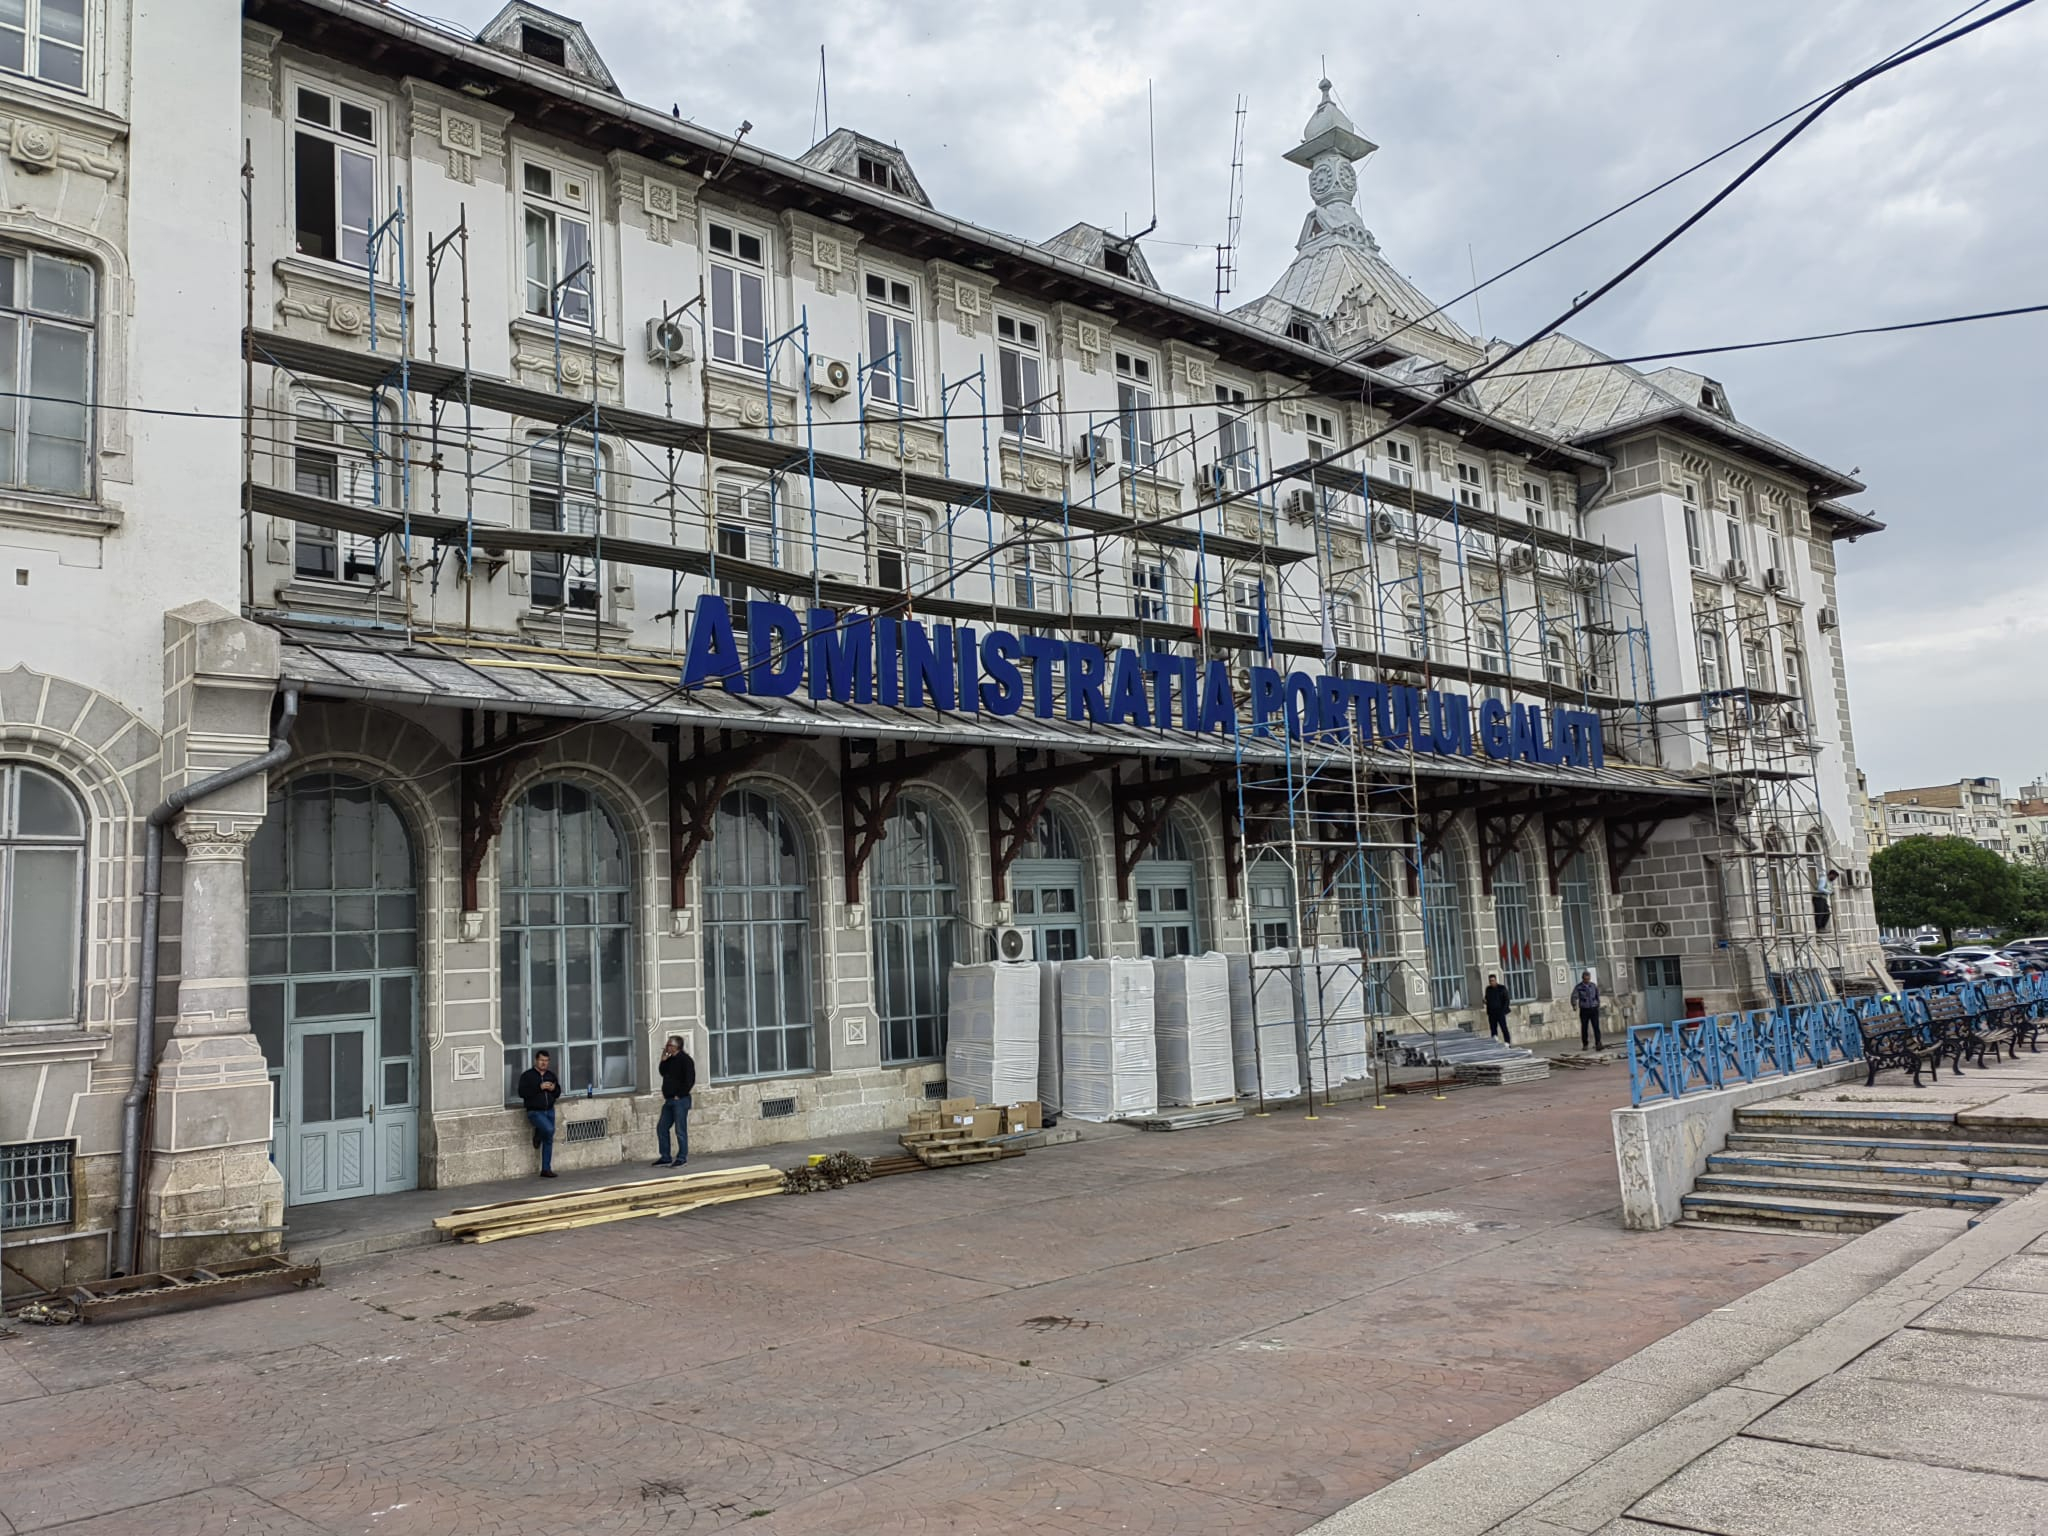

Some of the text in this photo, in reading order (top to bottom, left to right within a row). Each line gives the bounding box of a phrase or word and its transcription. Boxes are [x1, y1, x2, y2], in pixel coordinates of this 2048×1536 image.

[680, 594, 1604, 769] ADMINISTRATIA PORTULUI GALATI
